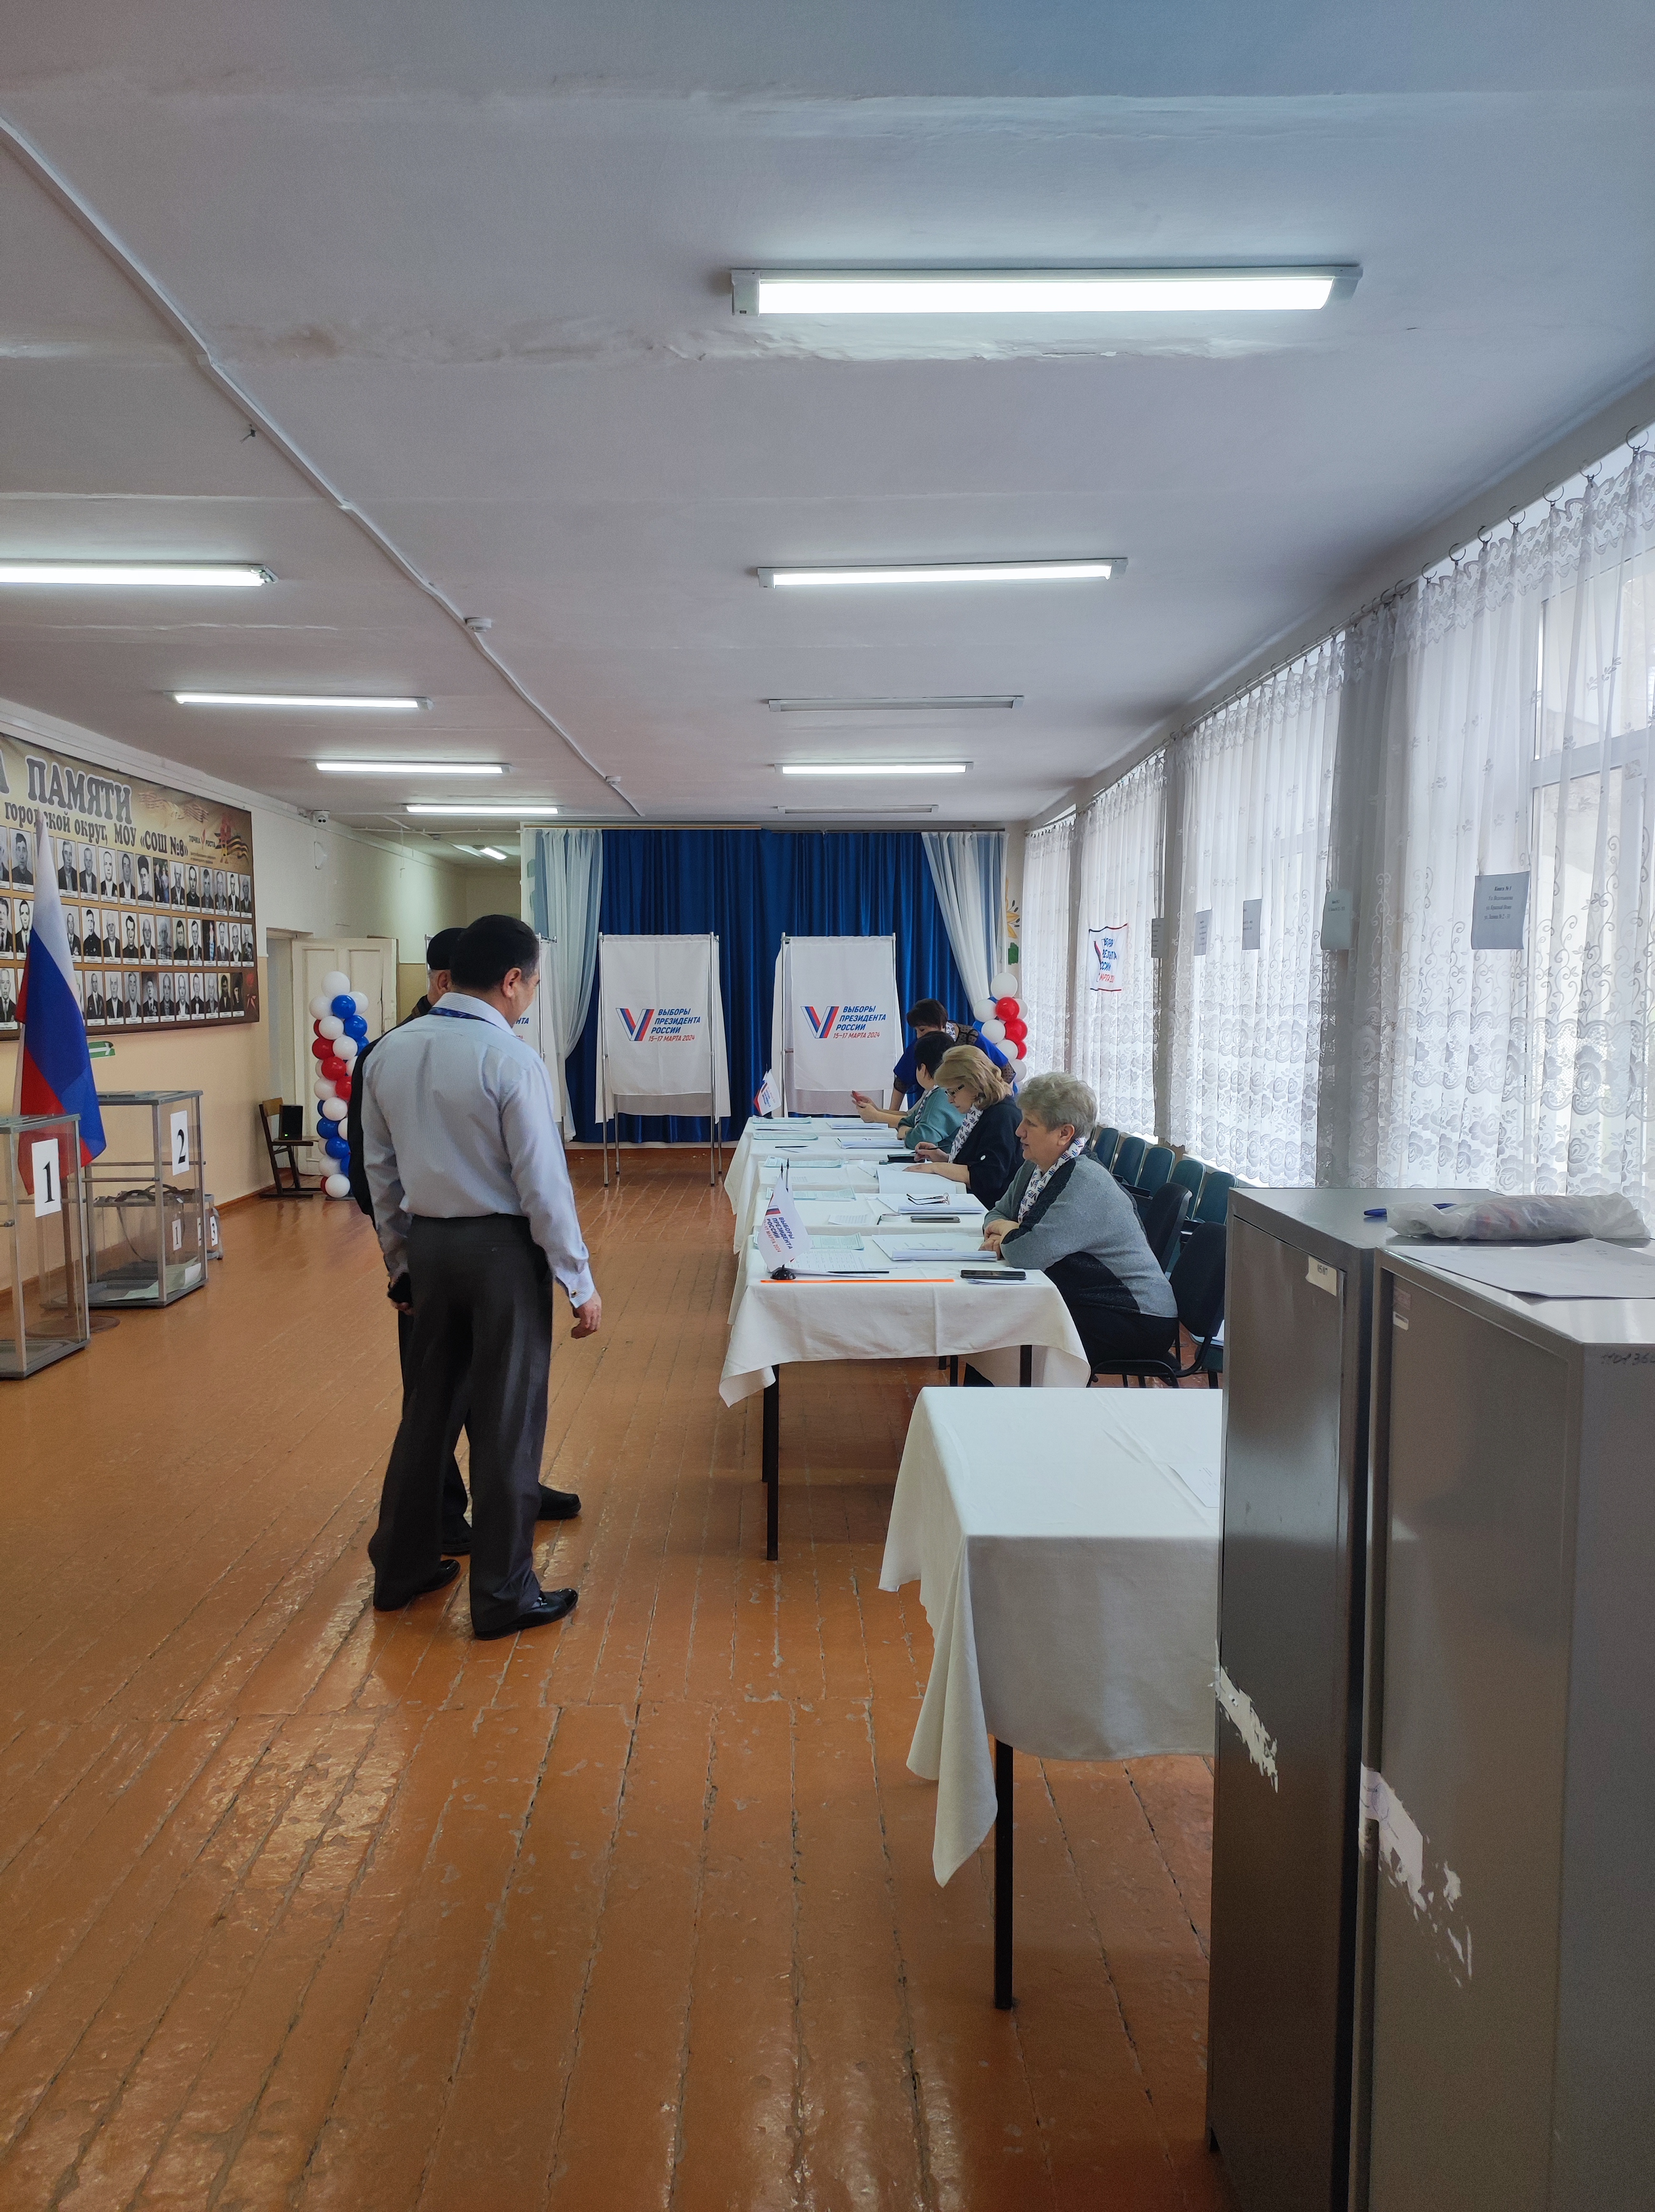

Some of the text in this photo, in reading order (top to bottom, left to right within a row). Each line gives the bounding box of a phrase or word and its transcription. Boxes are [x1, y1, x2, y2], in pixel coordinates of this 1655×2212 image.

[26, 758, 132, 825] ПАМЯТИ
[5, 802, 188, 857] горокой округ, МОУ «СОШ №8»
[654, 1016, 701, 1025] ПРЕЗИДЕНТА
[839, 1014, 886, 1022] ПРЕЗИДЕНТА
[176, 1128, 187, 1164] 2
[43, 1161, 56, 1203] 1
[766, 1219, 780, 1239] РОССИИ
[766, 1230, 776, 1244] МАРТА
[773, 1244, 782, 1252] 2024
[772, 1218, 793, 1249] ПРЕЗИДЕНТА
[778, 1217, 795, 1239] ВЫБОРЫ
